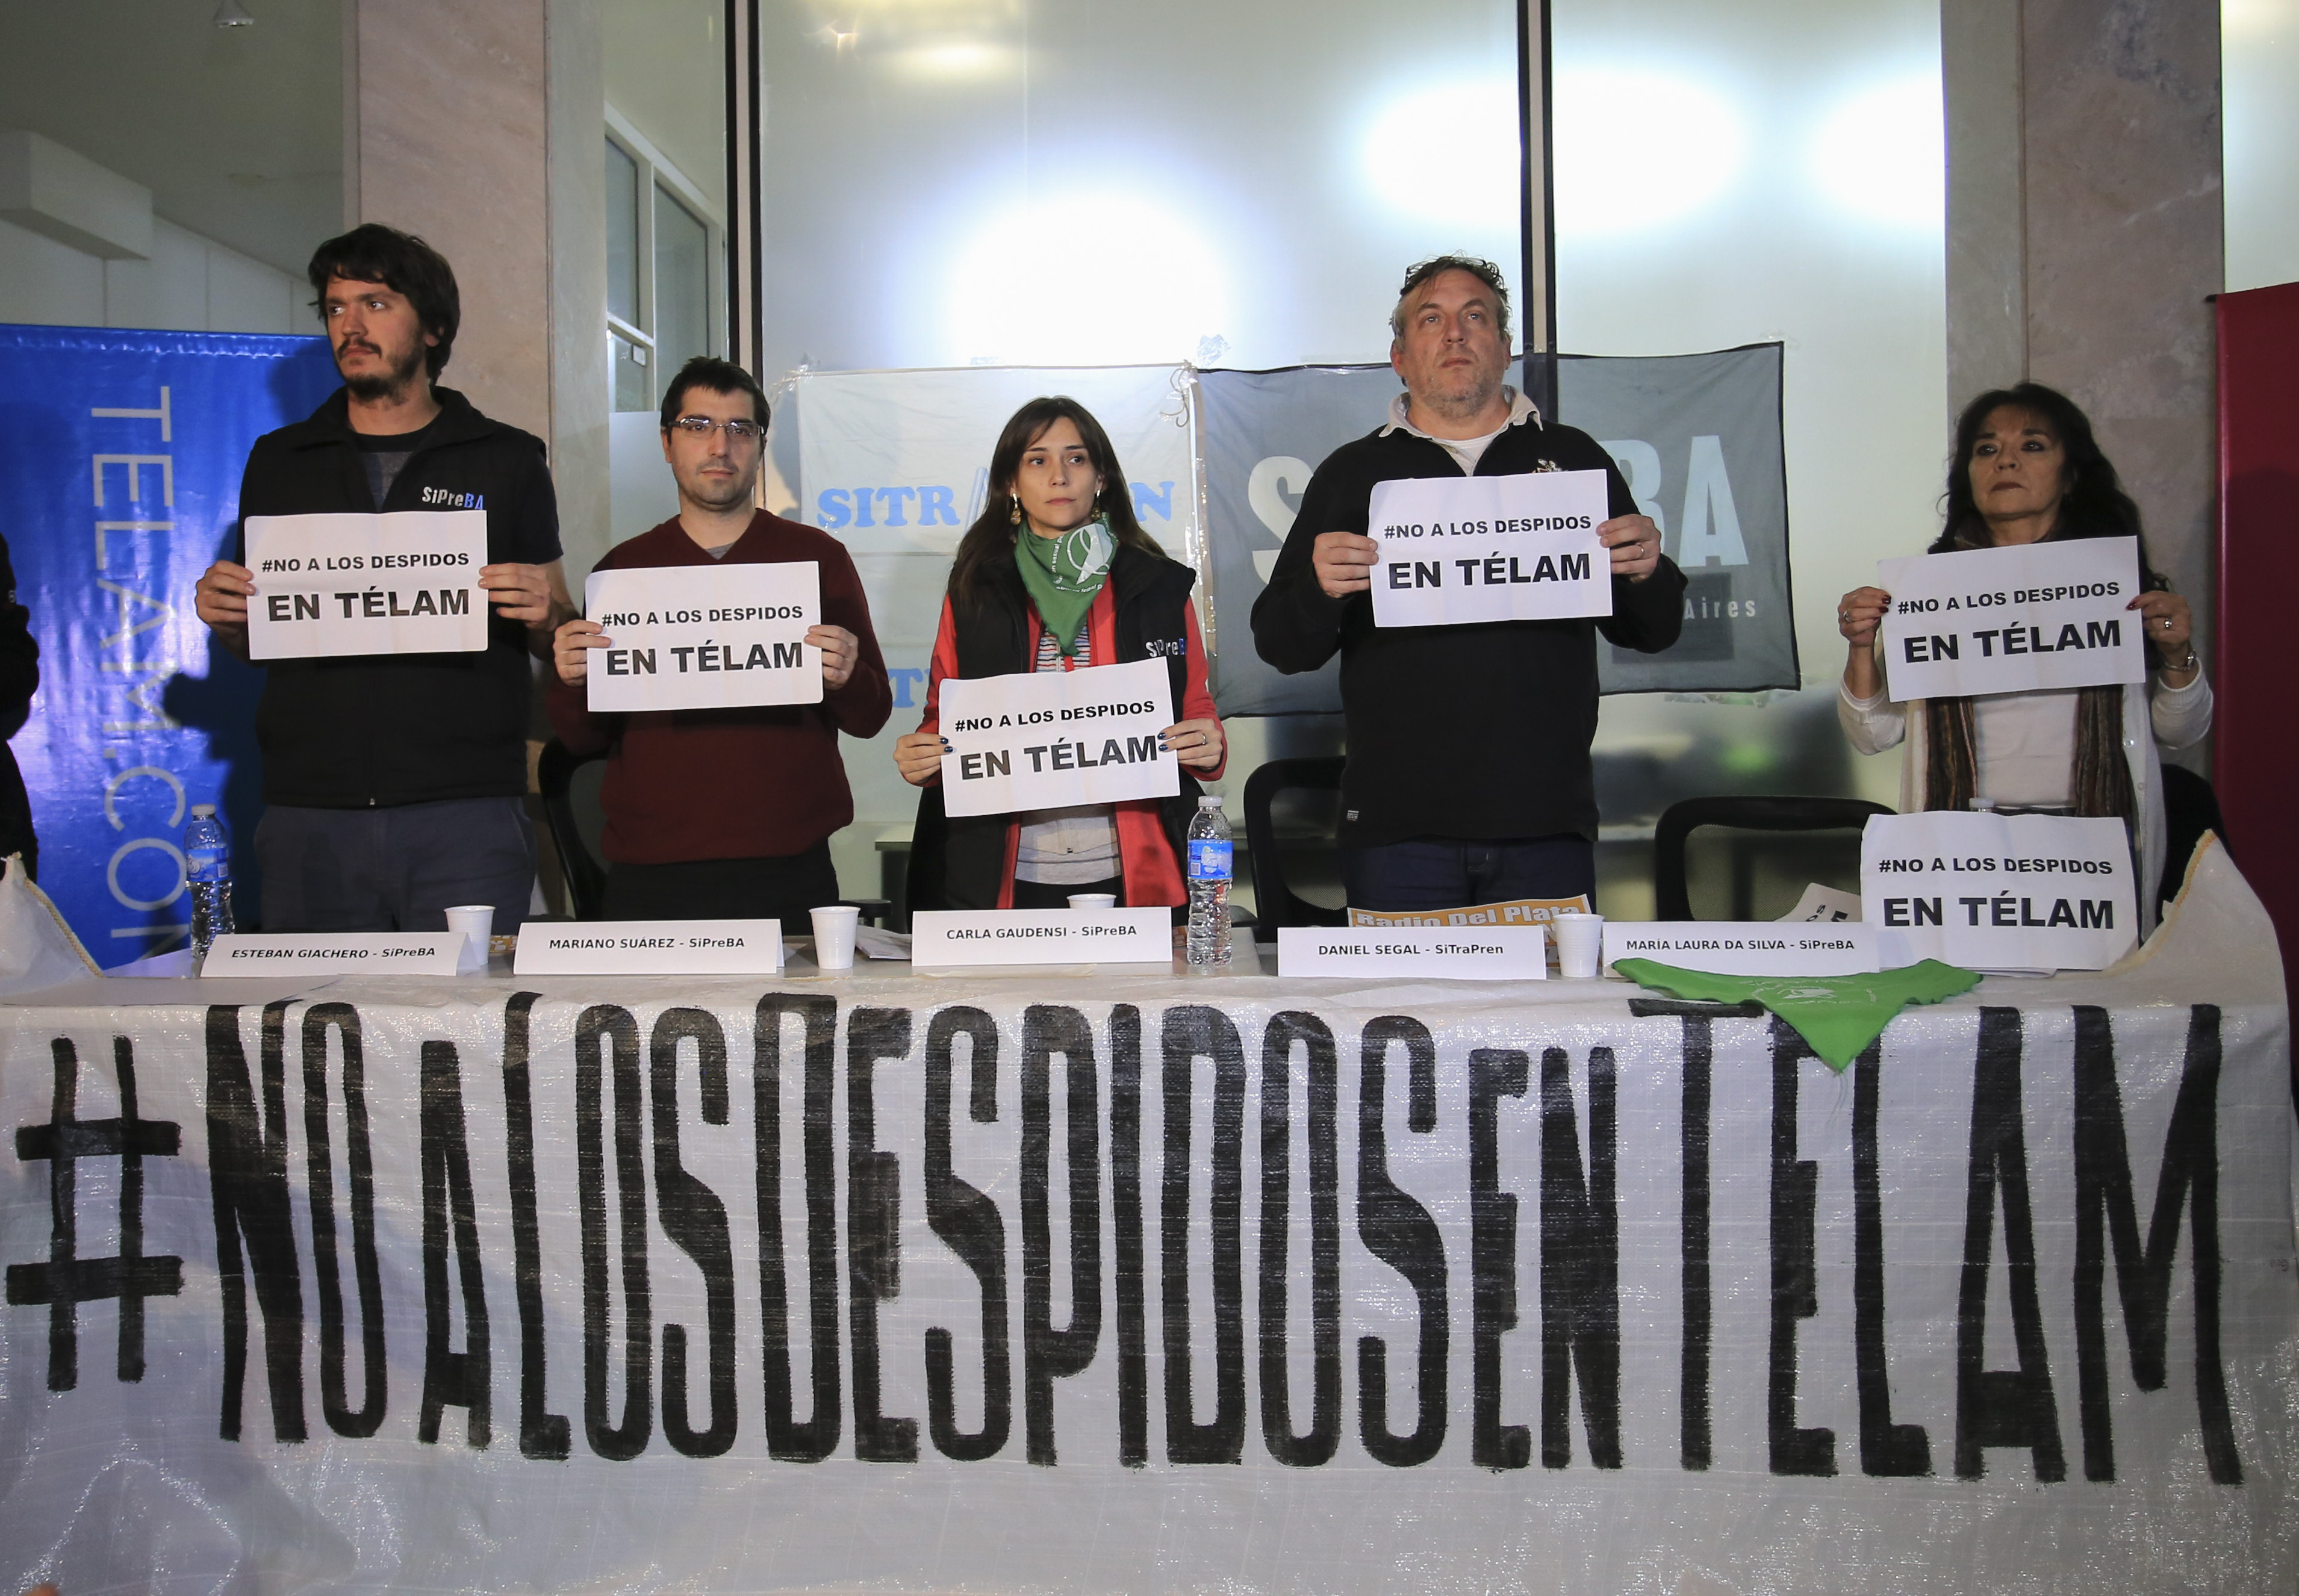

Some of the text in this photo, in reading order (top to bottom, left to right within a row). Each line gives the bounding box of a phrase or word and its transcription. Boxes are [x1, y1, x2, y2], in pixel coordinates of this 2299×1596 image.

[1384, 516, 1591, 538] #NO A LOS DESPIDOS
[263, 553, 468, 572] #NO A LOS DESPIDOS
[1389, 551, 1590, 589] EN TÉLAM
[268, 586, 468, 621] EN TÉLAM
[1684, 597, 1756, 619] Aires
[1898, 582, 2119, 614] #NO A LOS DESPIDOS
[600, 606, 803, 628] #NO A LOS DESPIDOS
[1904, 620, 2120, 663] EN TÉLAM
[605, 640, 802, 675] EN TÉLAM
[956, 701, 1154, 731] #NO A LOS DESPIDOS
[960, 735, 1159, 780] EN TÉLAM
[1879, 858, 2112, 874] #NO A LOS DESPIDOS
[1448, 909, 1497, 926] Del
[1884, 898, 1942, 926] EN
[1959, 890, 2114, 929] TÉLAM
[549, 939, 615, 949] MARIANO
[620, 937, 675, 949] SUÁREZ
[689, 937, 744, 948] SiPreBA
[947, 929, 992, 940] CARLA
[996, 927, 1066, 939] GAUDENSI
[1081, 925, 1137, 936] SiPreBA
[231, 949, 294, 958] ESTEBAN
[297, 949, 369, 958] GIACHERO
[381, 948, 435, 957] SiPreBA
[1319, 945, 1370, 955] DANIEL
[1375, 945, 1421, 955] SEGAL
[1435, 944, 1504, 954] SiTraPren
[1626, 938, 1671, 950] MARÍA
[1675, 940, 1720, 950] LAURA
[1725, 940, 1744, 949] DA
[1748, 940, 1786, 949] SILVA
[1799, 940, 1855, 949] SiPreBA
[5, 991, 2244, 1487] #NO A LOS DESPIDOS EN TELAM
